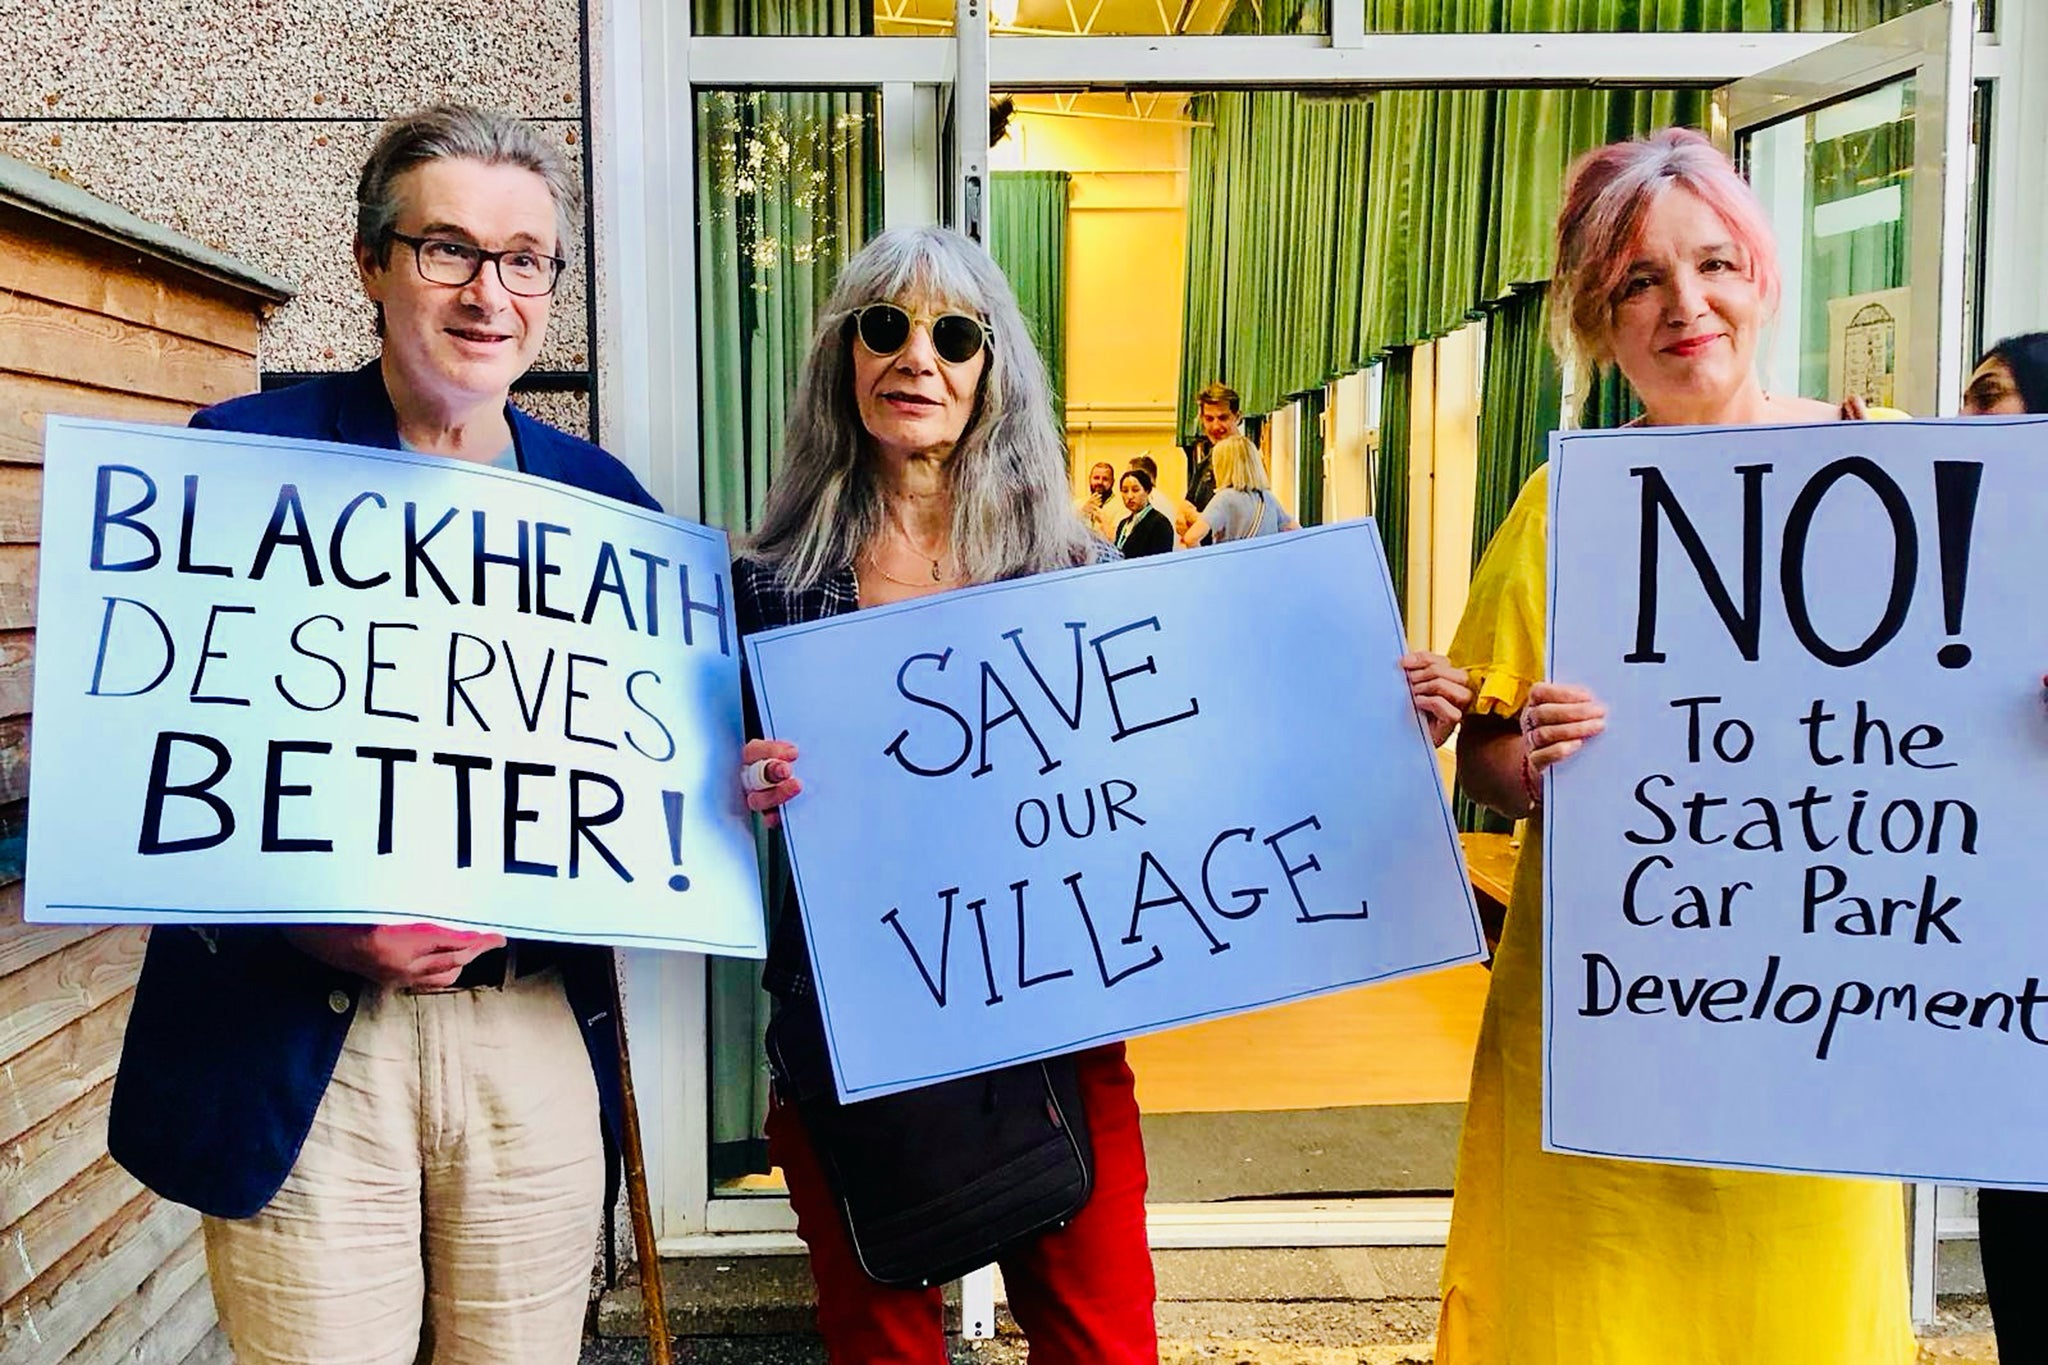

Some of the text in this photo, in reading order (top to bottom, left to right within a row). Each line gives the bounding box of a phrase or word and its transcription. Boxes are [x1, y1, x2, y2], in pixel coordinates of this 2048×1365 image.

[89, 464, 731, 656] BLACKHEATH
[1624, 456, 1984, 669] NO!
[86, 596, 678, 762] DESERVES
[883, 616, 1199, 778] SAVE
[1671, 696, 1958, 769] To the
[1014, 779, 1146, 848] OUR
[1624, 775, 1979, 855] Station
[880, 815, 1368, 1007] VILLAGE
[1622, 855, 1962, 944] Car Park
[1578, 952, 2048, 1060] Development
